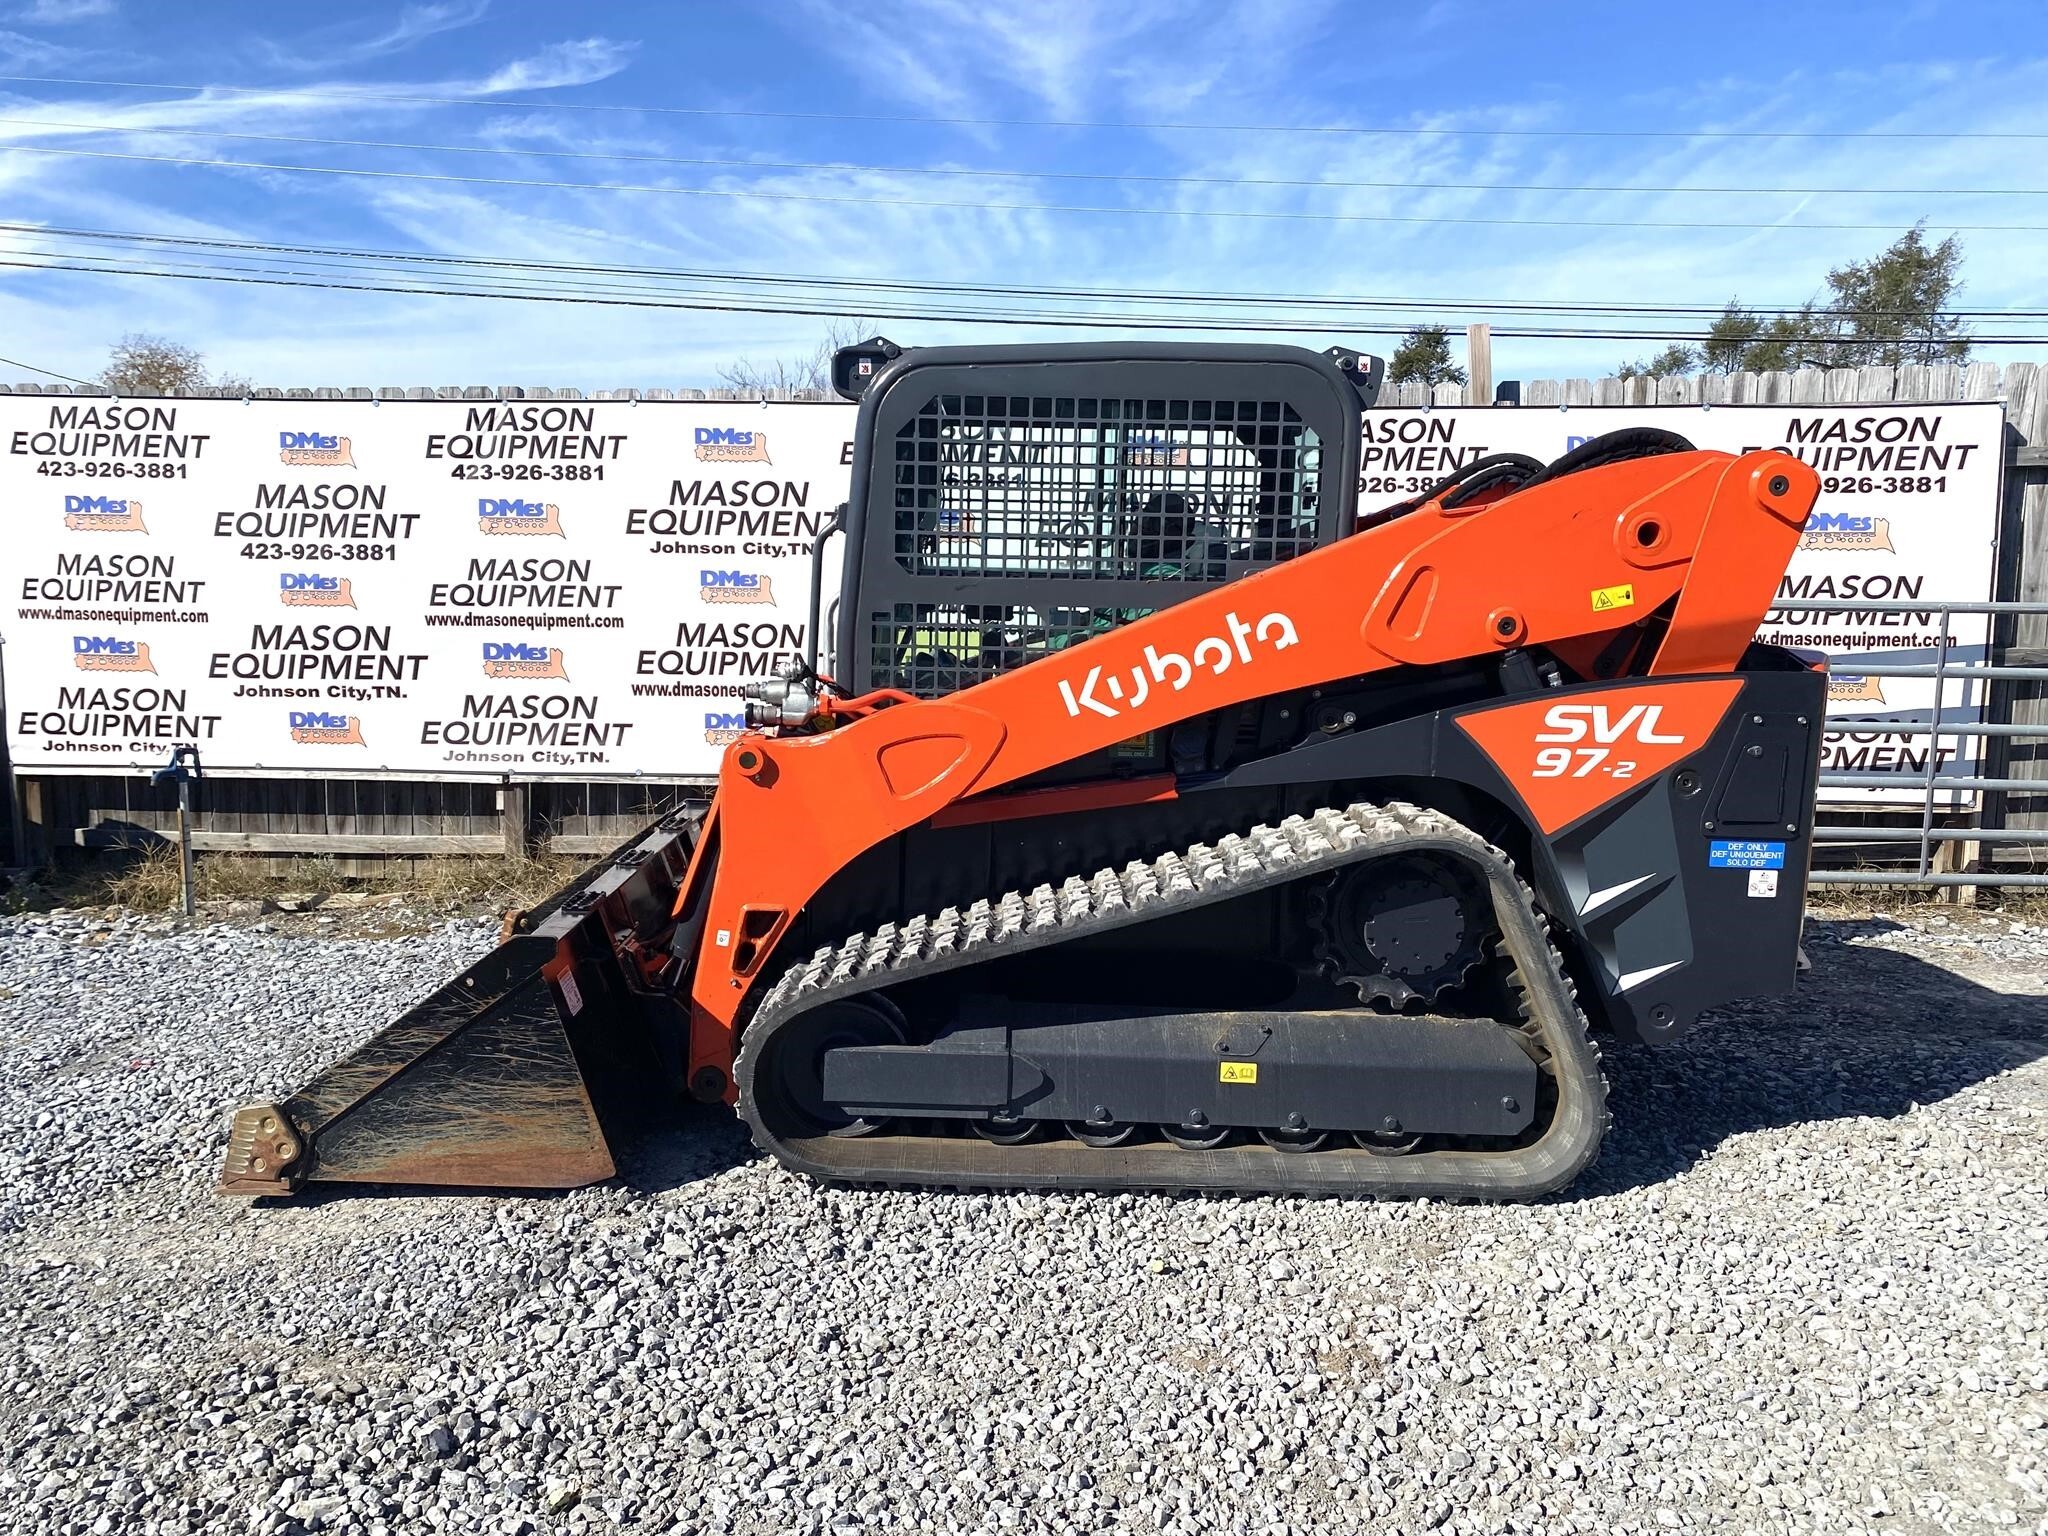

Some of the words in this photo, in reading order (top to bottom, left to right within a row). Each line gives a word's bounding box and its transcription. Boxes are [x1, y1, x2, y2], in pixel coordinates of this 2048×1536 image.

[50, 406, 176, 431] MASON
[466, 407, 594, 432] MASON
[1361, 418, 1455, 443] ASON
[1786, 417, 1941, 443] MASON
[10, 432, 210, 458] EQUIPMENT
[426, 435, 627, 459] EQUIPMENT
[37, 461, 186, 479] 423-926-3881
[1361, 447, 1488, 471] PMENT
[1740, 445, 1979, 471] UIPMENT
[451, 464, 603, 480] 423-926-3881
[670, 480, 809, 507] MASON
[1823, 476, 1946, 493] 926-3881
[256, 484, 386, 510] MASON
[214, 512, 420, 538] EQUIPMENT
[241, 543, 395, 560] 423-926-3881
[650, 541, 735, 554] Johnson
[743, 543, 814, 558] City,TN
[57, 554, 174, 577] MASON
[468, 559, 590, 582] MASON
[22, 578, 205, 603] EQUIPMENT
[430, 584, 622, 607] EQUIPMENT
[1777, 575, 1924, 600] MASON
[18, 606, 208, 625] www.dmasonequipment.com
[425, 612, 624, 631] www.dmasonequipment.com
[251, 625, 391, 651] MASON
[676, 623, 804, 648] MASON
[209, 653, 428, 680] EQUIPMENT
[637, 650, 822, 676] EQUIPM
[1058, 612, 1299, 718] Kubota
[58, 687, 186, 711] MASON
[234, 685, 320, 697] Johnson
[327, 686, 407, 701] City,TN.
[631, 681, 746, 701] www.dmasoneq
[463, 695, 598, 719] MASON
[18, 712, 221, 738] EQUIPMENT
[421, 721, 633, 746] EQUIPMENT
[1535, 704, 1685, 744] SVL
[43, 741, 122, 751] Johnson
[444, 751, 524, 762] Johnson
[532, 751, 609, 765] City,TN.
[1531, 747, 1637, 778] 97-2
[1821, 747, 1955, 773] PMENT
[1711, 850, 1728, 858] DEF
[1730, 851, 1783, 859] UNIQUEMENT
[1727, 842, 1744, 851] DEF
[1746, 843, 1769, 852] ONLY
[1726, 859, 1748, 867] SOLO
[1750, 859, 1767, 867] DEF
